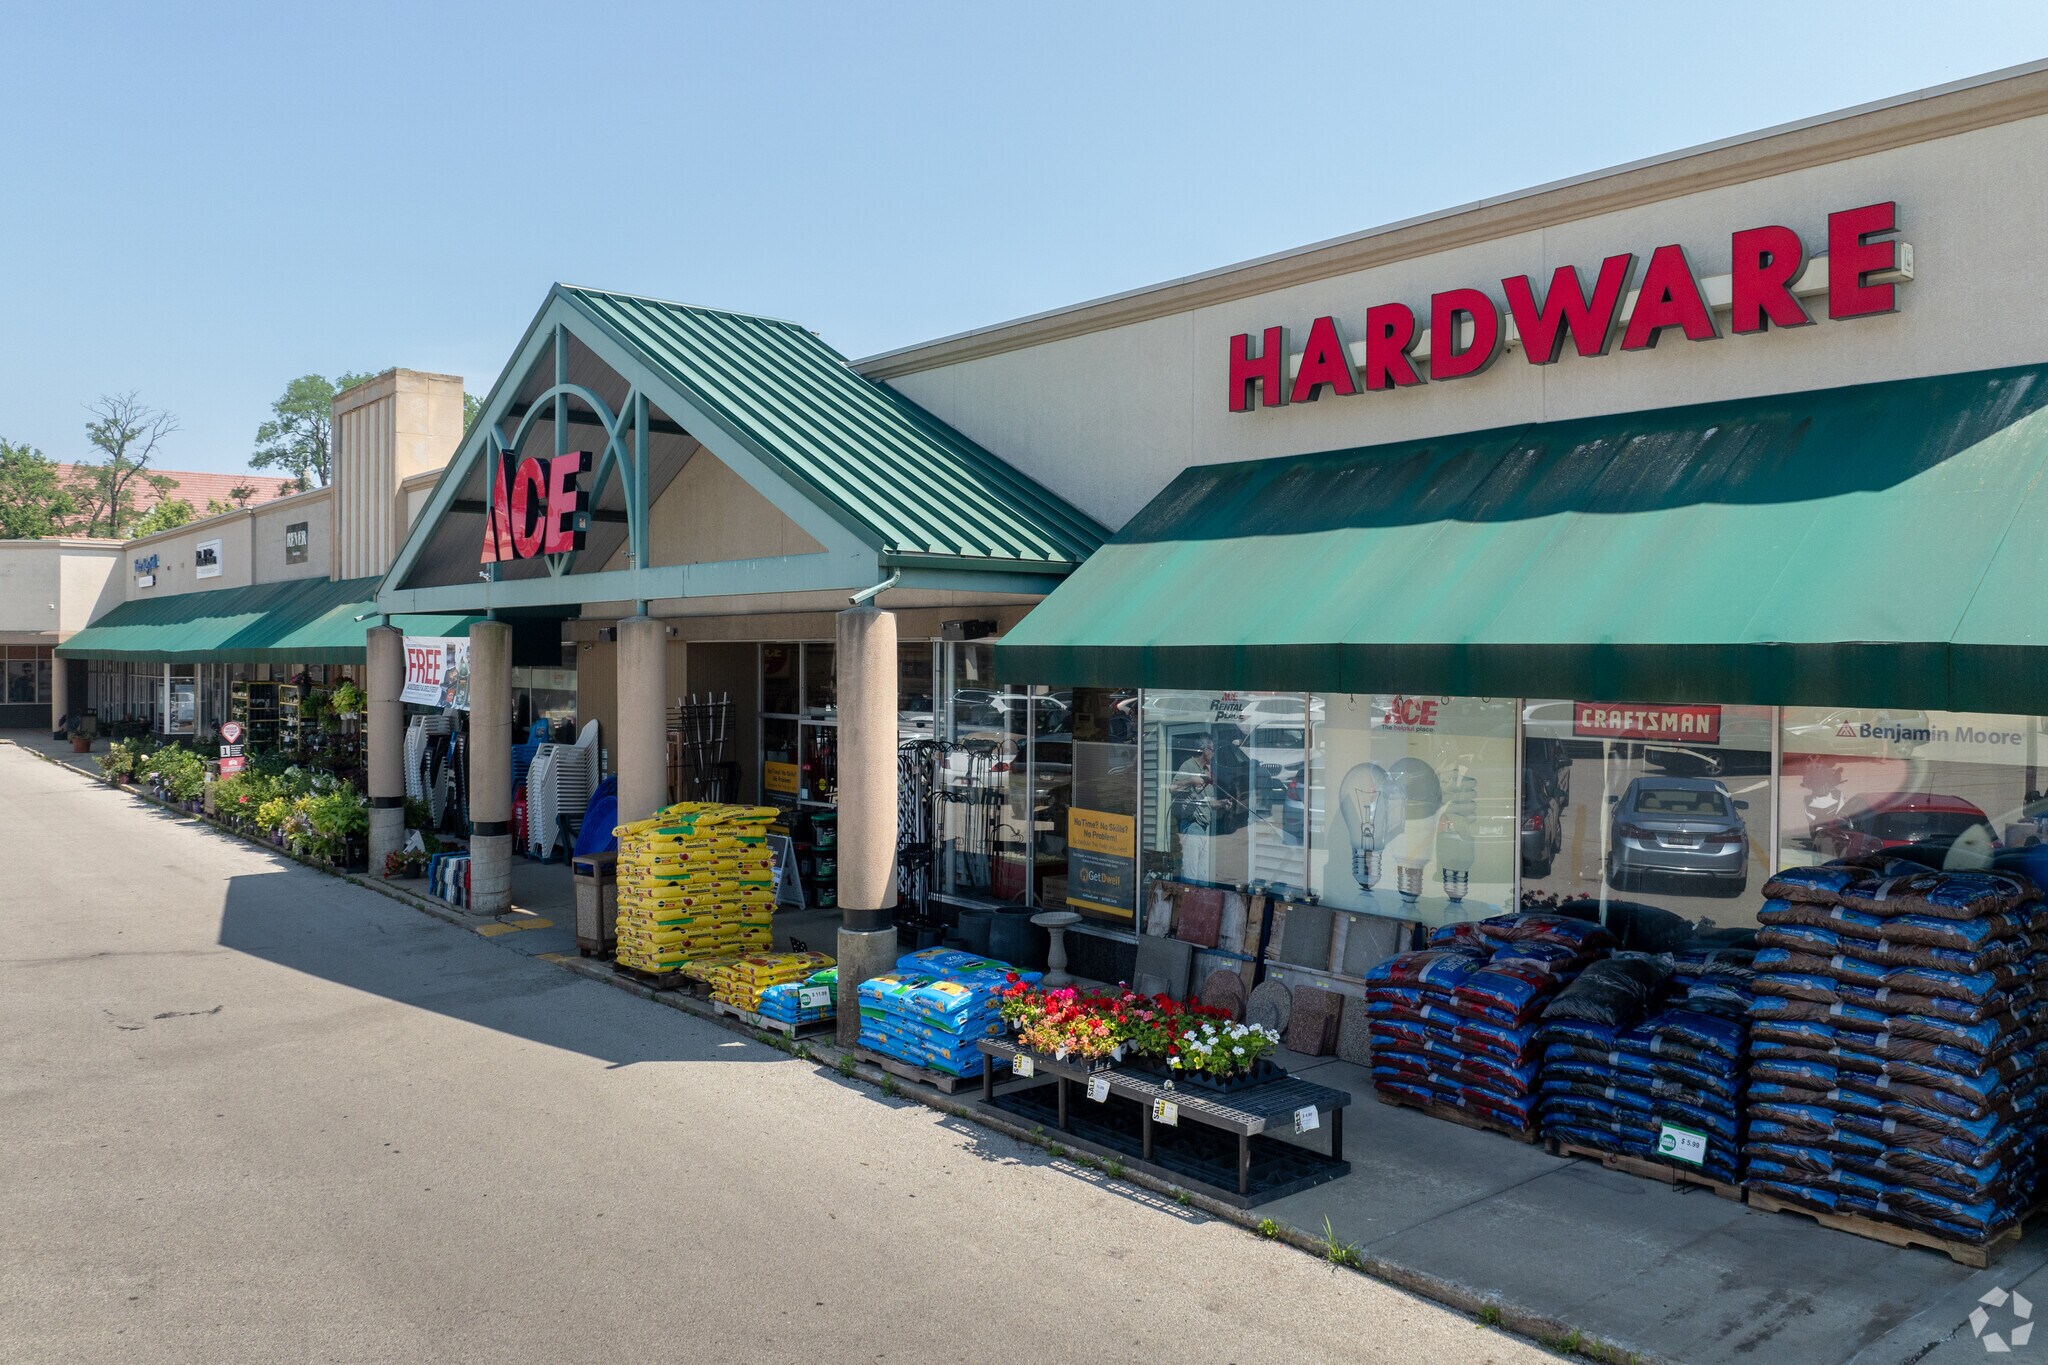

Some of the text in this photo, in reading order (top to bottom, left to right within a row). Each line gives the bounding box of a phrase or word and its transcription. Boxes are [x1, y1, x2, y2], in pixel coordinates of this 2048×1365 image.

[1229, 201, 1898, 413] HARDWARE
[480, 450, 590, 564] ACE
[407, 648, 441, 686] FREE
[1210, 700, 1243, 711] RENTAL
[1382, 693, 1438, 725] ACE
[1394, 725, 1415, 733] helpful
[1581, 708, 1710, 734] CRAFTSMAN
[1859, 722, 2022, 745] Benjamin Moore
[1074, 818, 1128, 834] No Time? No Skills?
[1083, 830, 1117, 842] No Problem!
[1088, 870, 1120, 885] GetDwell
[1686, 1138, 1700, 1149] 5.99
